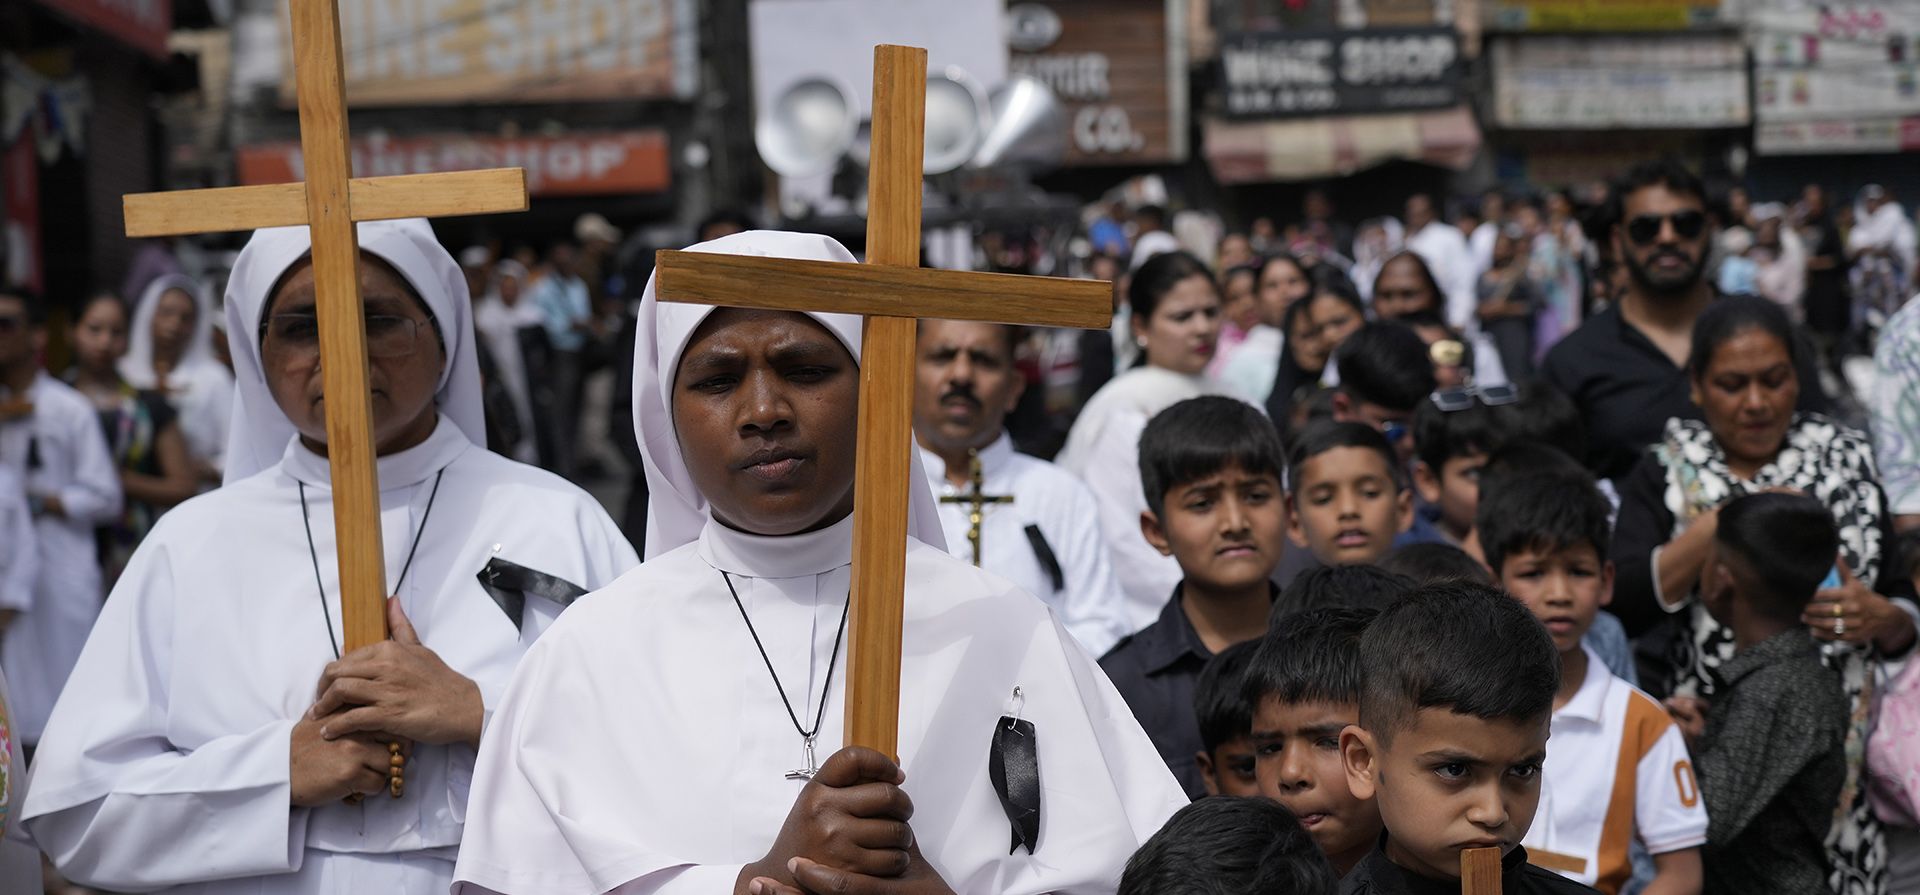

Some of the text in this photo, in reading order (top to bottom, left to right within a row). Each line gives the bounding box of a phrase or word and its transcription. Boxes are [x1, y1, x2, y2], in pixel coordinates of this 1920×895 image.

[484, 0, 664, 77] SHOP
[1223, 41, 1334, 89] WINE
[1340, 35, 1457, 85] SHOP
[1074, 105, 1146, 153] CO.
